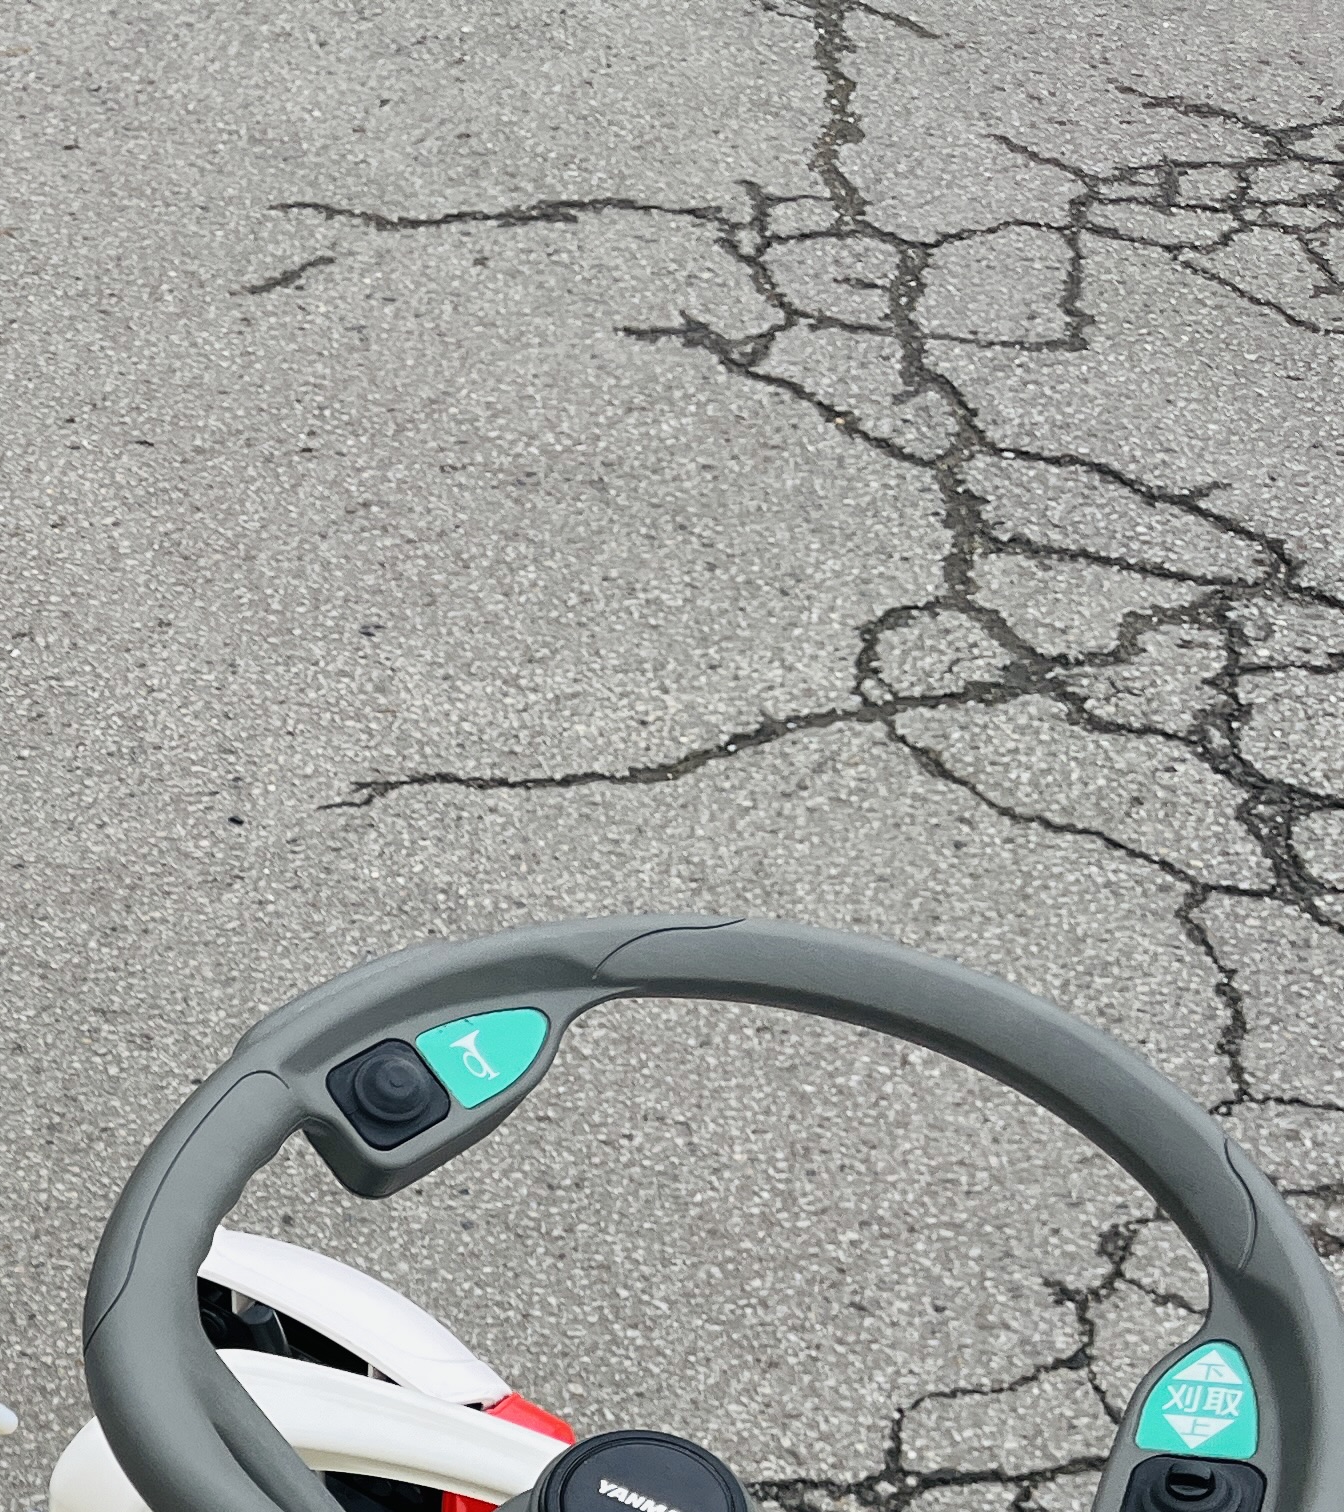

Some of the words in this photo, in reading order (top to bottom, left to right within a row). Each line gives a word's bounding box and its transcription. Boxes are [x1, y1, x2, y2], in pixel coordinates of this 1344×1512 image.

[1198, 1363, 1225, 1381] 下
[1162, 1384, 1243, 1417] 刈取
[1180, 1418, 1211, 1437] 上
